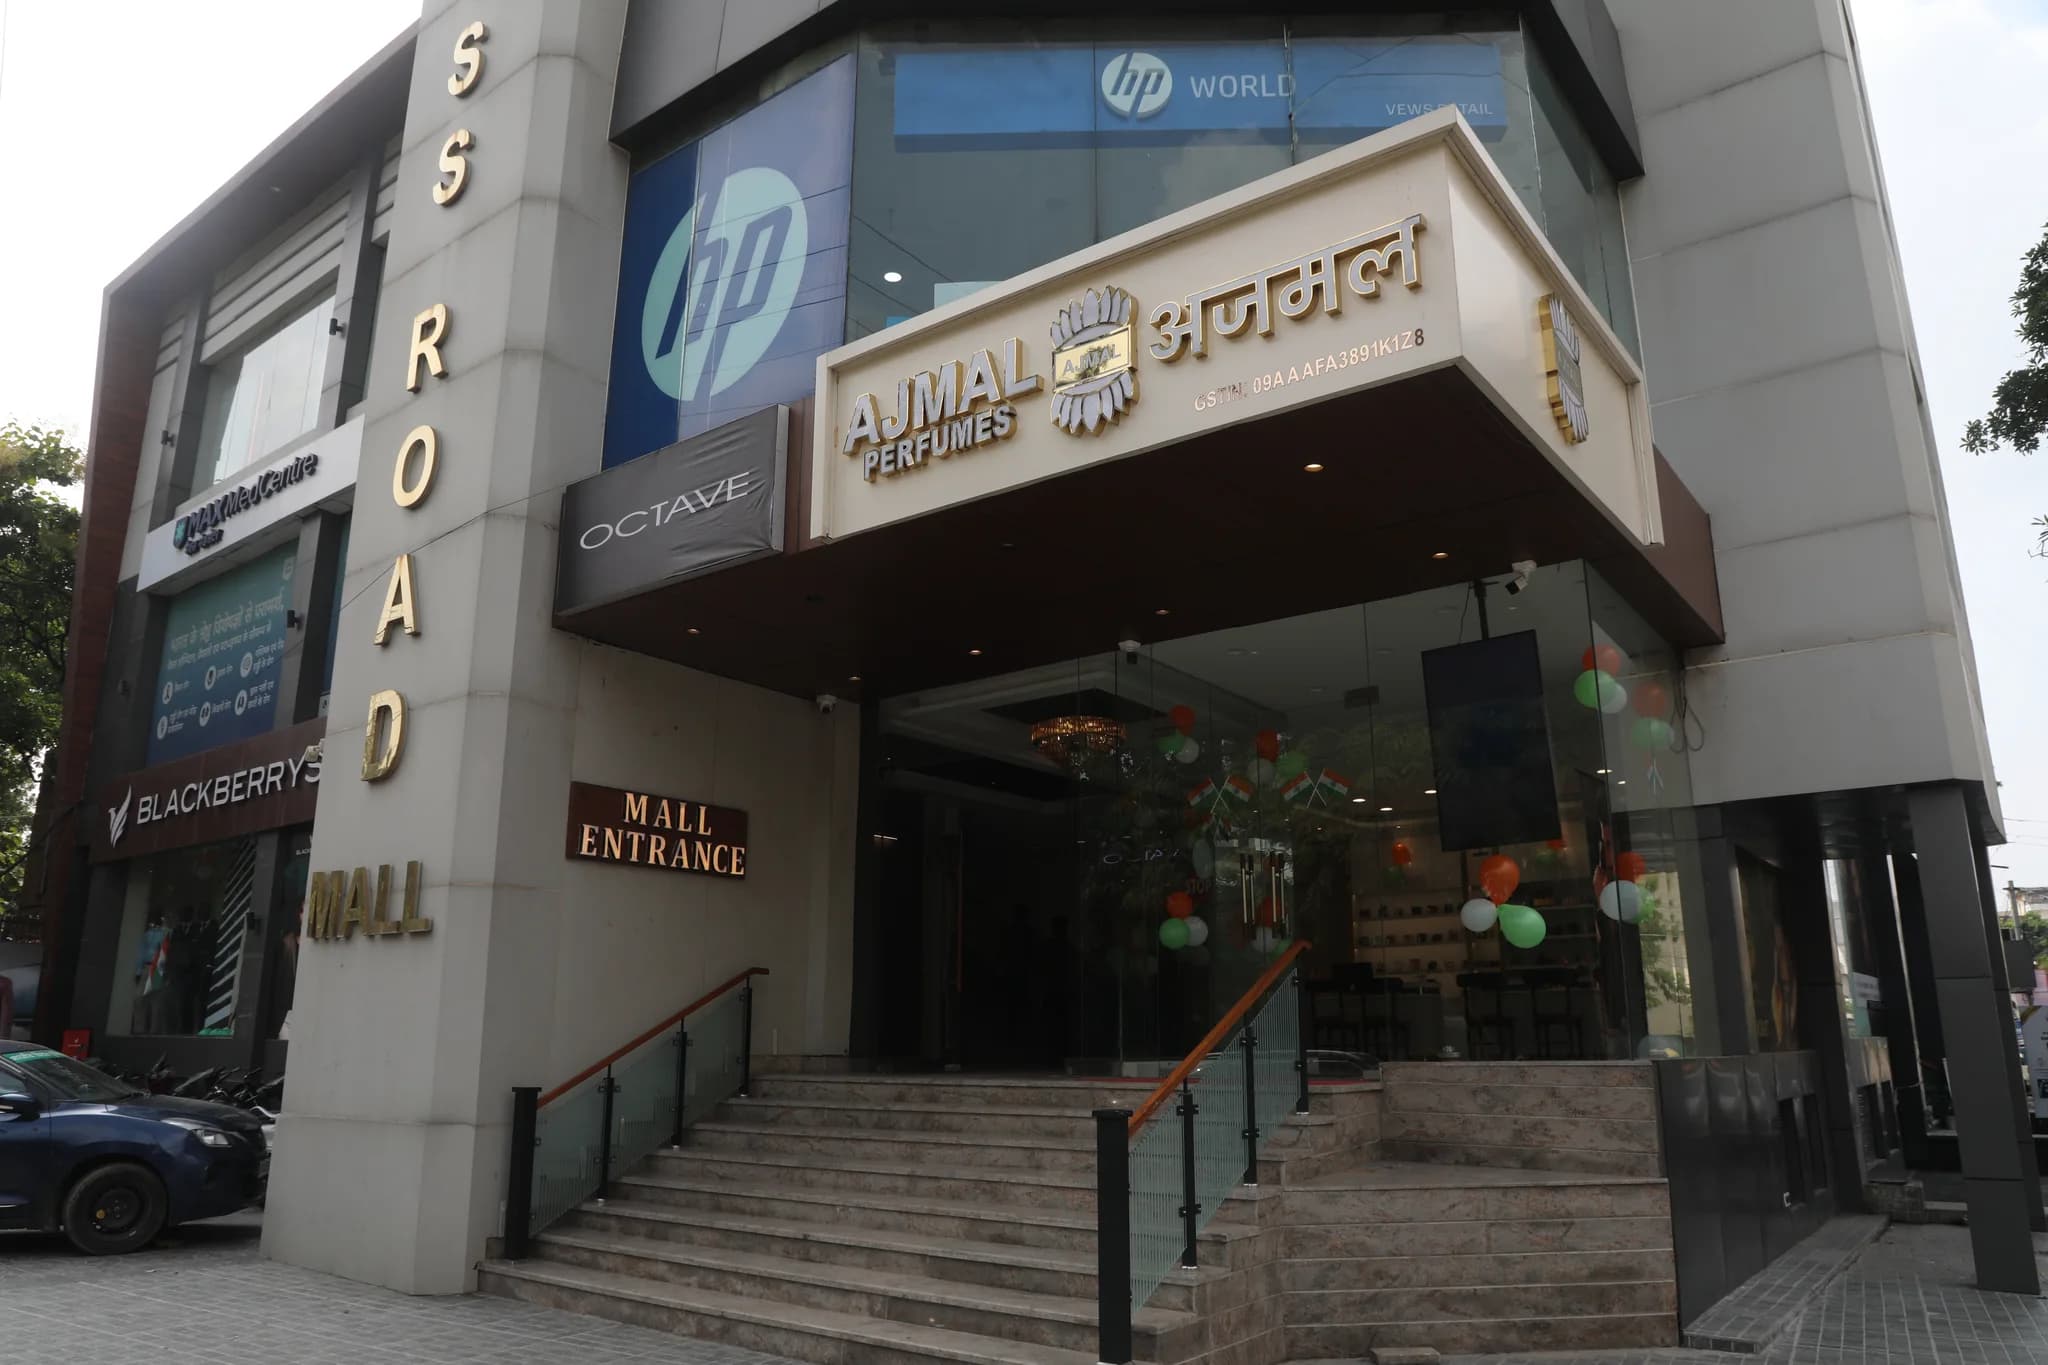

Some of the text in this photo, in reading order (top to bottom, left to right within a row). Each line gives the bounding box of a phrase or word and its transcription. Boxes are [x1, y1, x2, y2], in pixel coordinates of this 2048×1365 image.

[1106, 52, 1296, 118] hp WORLD
[1438, 103, 1494, 115] TAIL
[648, 170, 804, 401] hp
[1149, 213, 1426, 362] अजमल
[843, 336, 1044, 455] AJMAL
[1063, 343, 1121, 377] AJMAL
[864, 404, 1017, 482] PERFUMES
[187, 453, 319, 539] MAX MedCentre
[579, 471, 750, 550] OCTAVE
[579, 823, 745, 875] ENTRANCE
[624, 792, 712, 836] MALL
[306, 860, 433, 940] MALL
